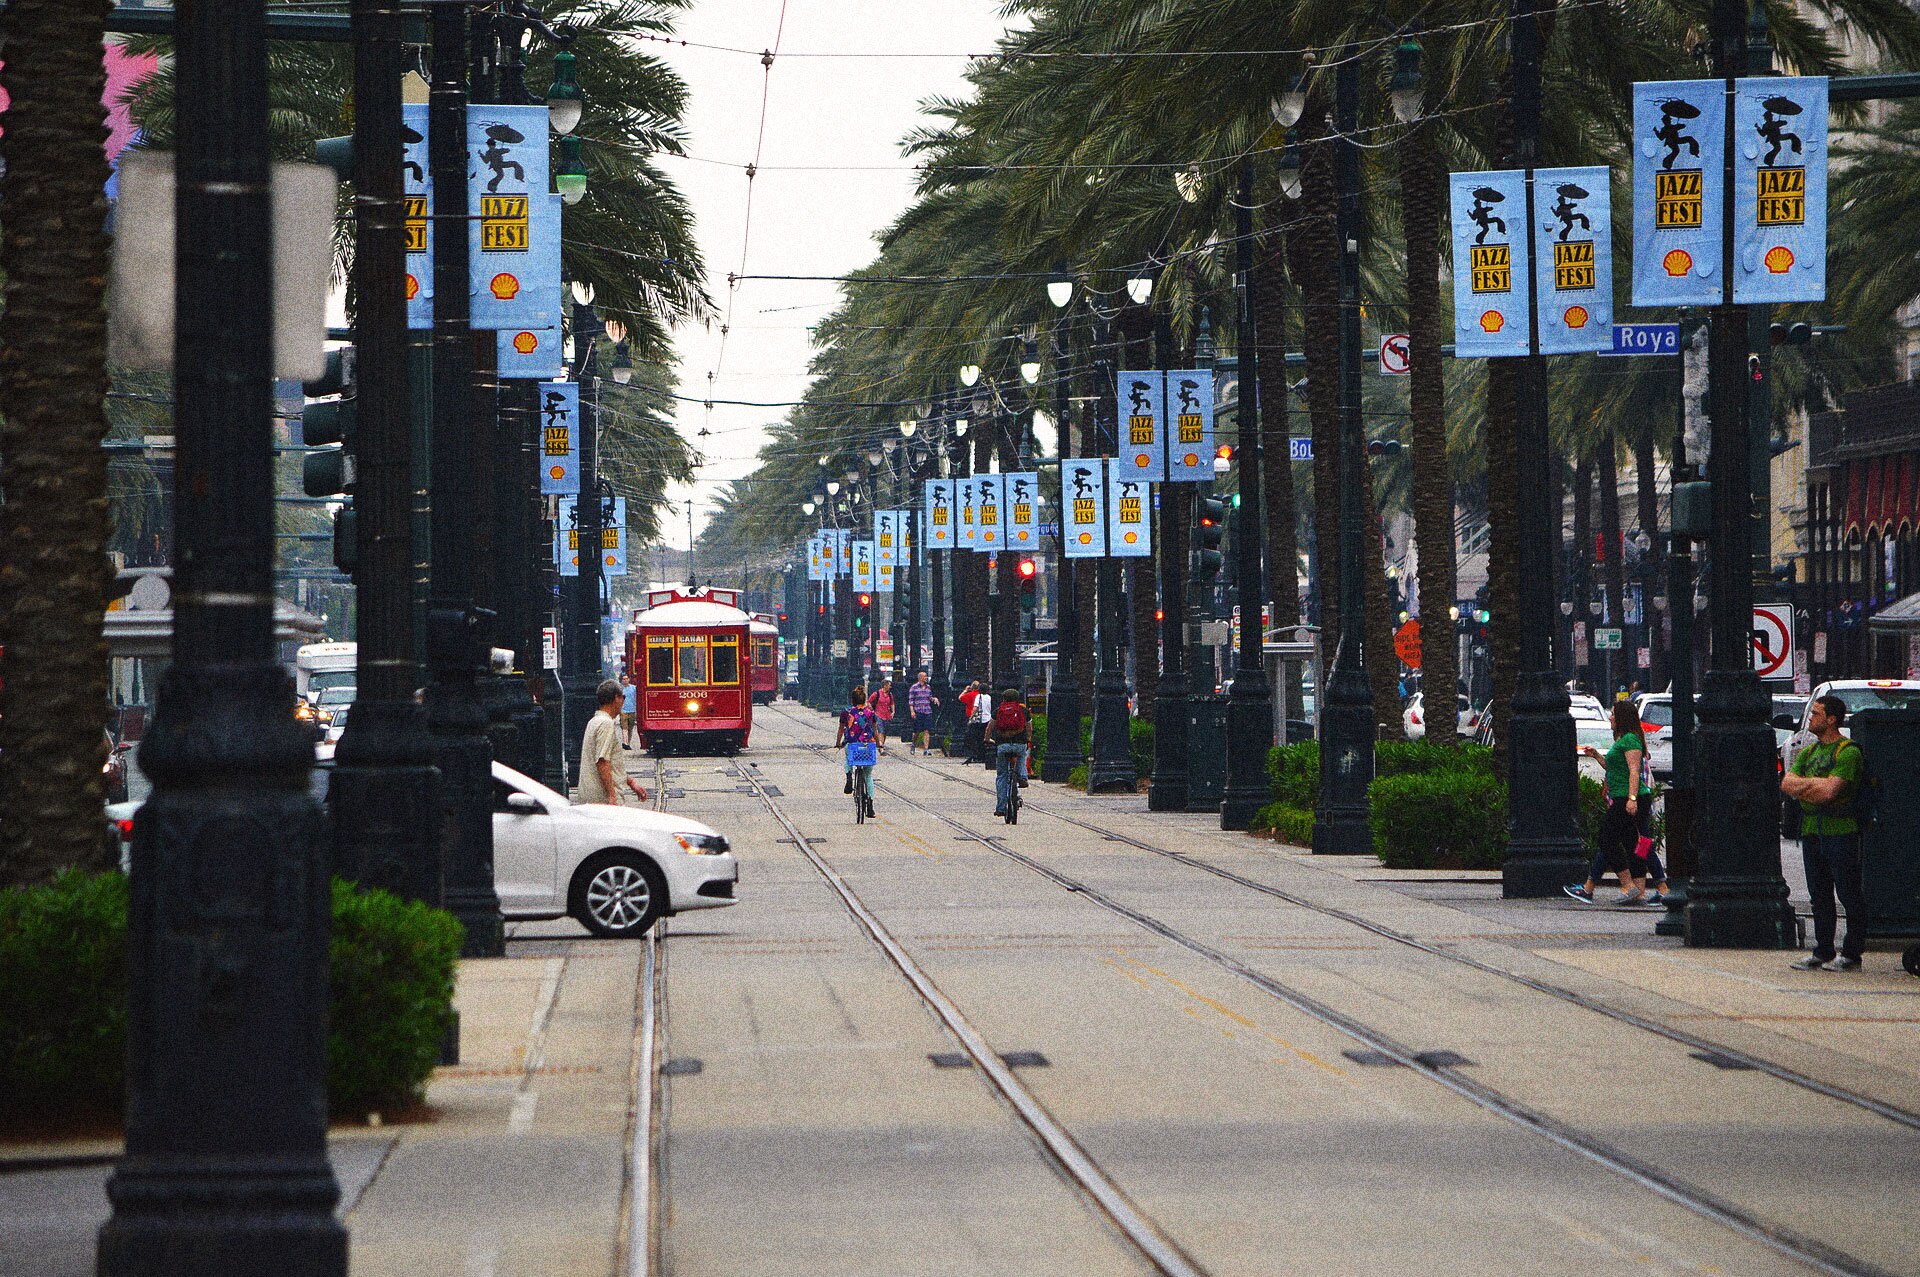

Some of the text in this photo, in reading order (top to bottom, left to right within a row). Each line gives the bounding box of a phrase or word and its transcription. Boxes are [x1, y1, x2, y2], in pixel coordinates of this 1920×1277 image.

[1657, 174, 1701, 200] JAZZ
[1759, 171, 1803, 197] JAZZ
[482, 198, 526, 223] JAZZ
[1658, 202, 1701, 223] FEST
[1759, 199, 1805, 221] FEST
[483, 225, 527, 247] FEST
[1472, 248, 1509, 269] JAZZ
[1556, 244, 1593, 267] JAZZ
[1473, 270, 1509, 289] FEST
[1556, 267, 1595, 286] FEST
[1621, 327, 1676, 353] Roya
[1131, 416, 1152, 430] JAZZ
[1180, 415, 1201, 428] JAZZ
[545, 428, 567, 441] JAZZ
[1131, 430, 1153, 442] FEST
[1180, 429, 1202, 441] FEST
[546, 442, 568, 454] FEST
[1074, 500, 1094, 511] JAZZ
[1120, 499, 1140, 510] JAZZ
[1075, 511, 1094, 522] FEST
[1121, 511, 1140, 521] FEST
